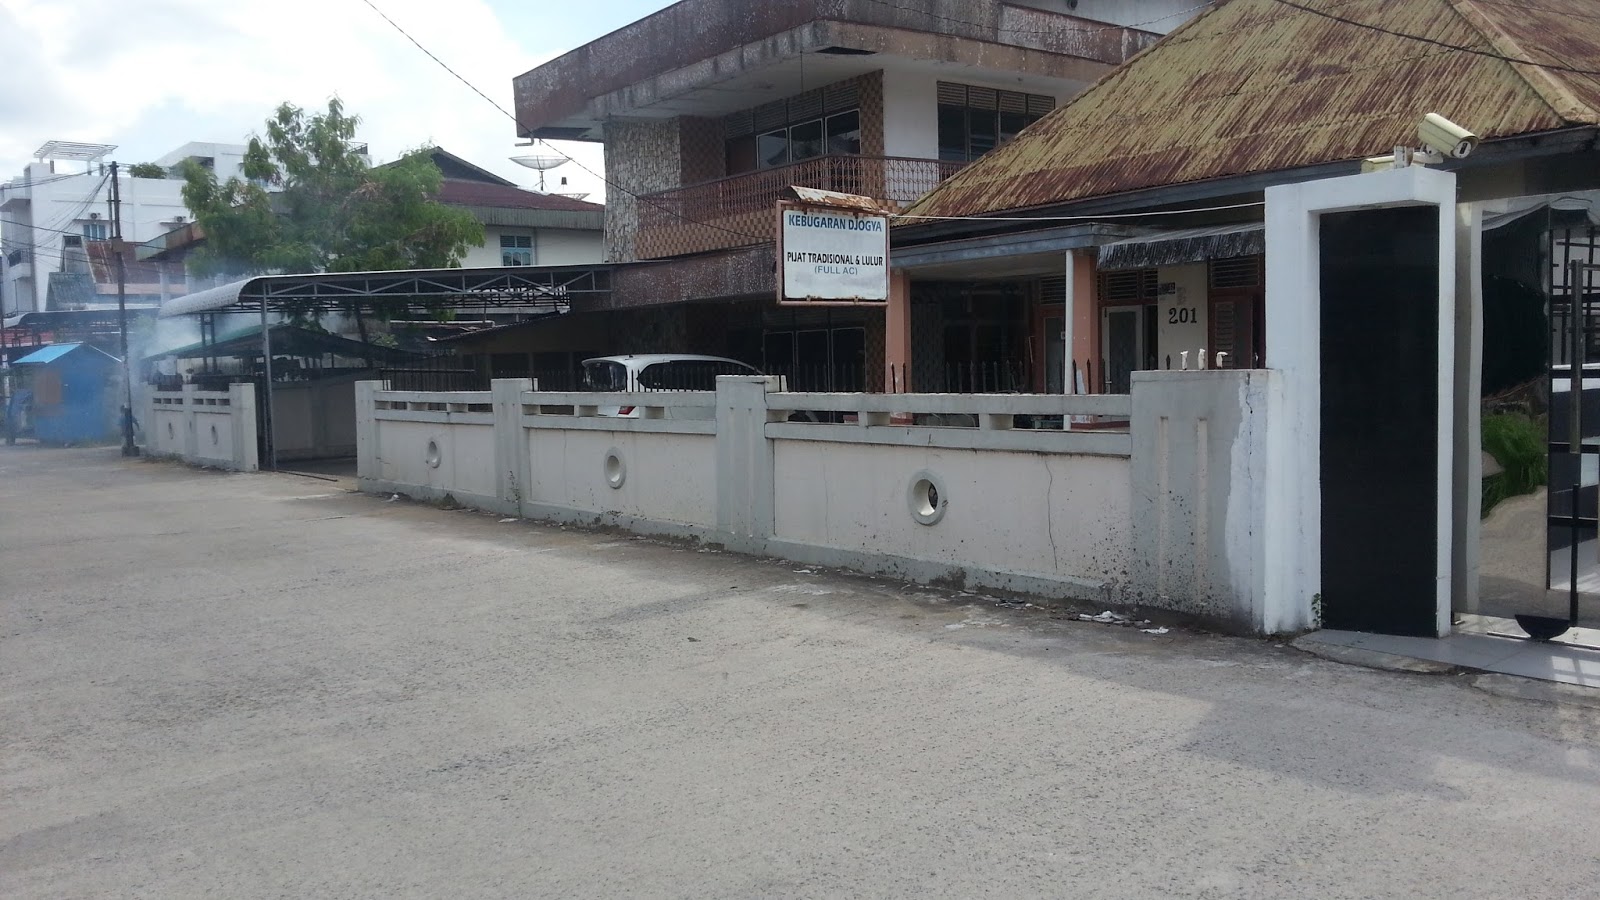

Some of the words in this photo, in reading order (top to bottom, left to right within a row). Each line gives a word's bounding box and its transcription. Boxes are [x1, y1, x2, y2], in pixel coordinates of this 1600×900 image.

[788, 214, 846, 229] KEBUGARAN
[848, 219, 882, 232] DJOGYA
[787, 251, 807, 263] PIJAT
[808, 253, 854, 265] TRADISIONAL
[855, 255, 861, 265] &
[862, 256, 883, 266] LULUR
[814, 265, 841, 274] (FULL
[842, 267, 858, 275] AC)
[1168, 307, 1197, 324] 201
